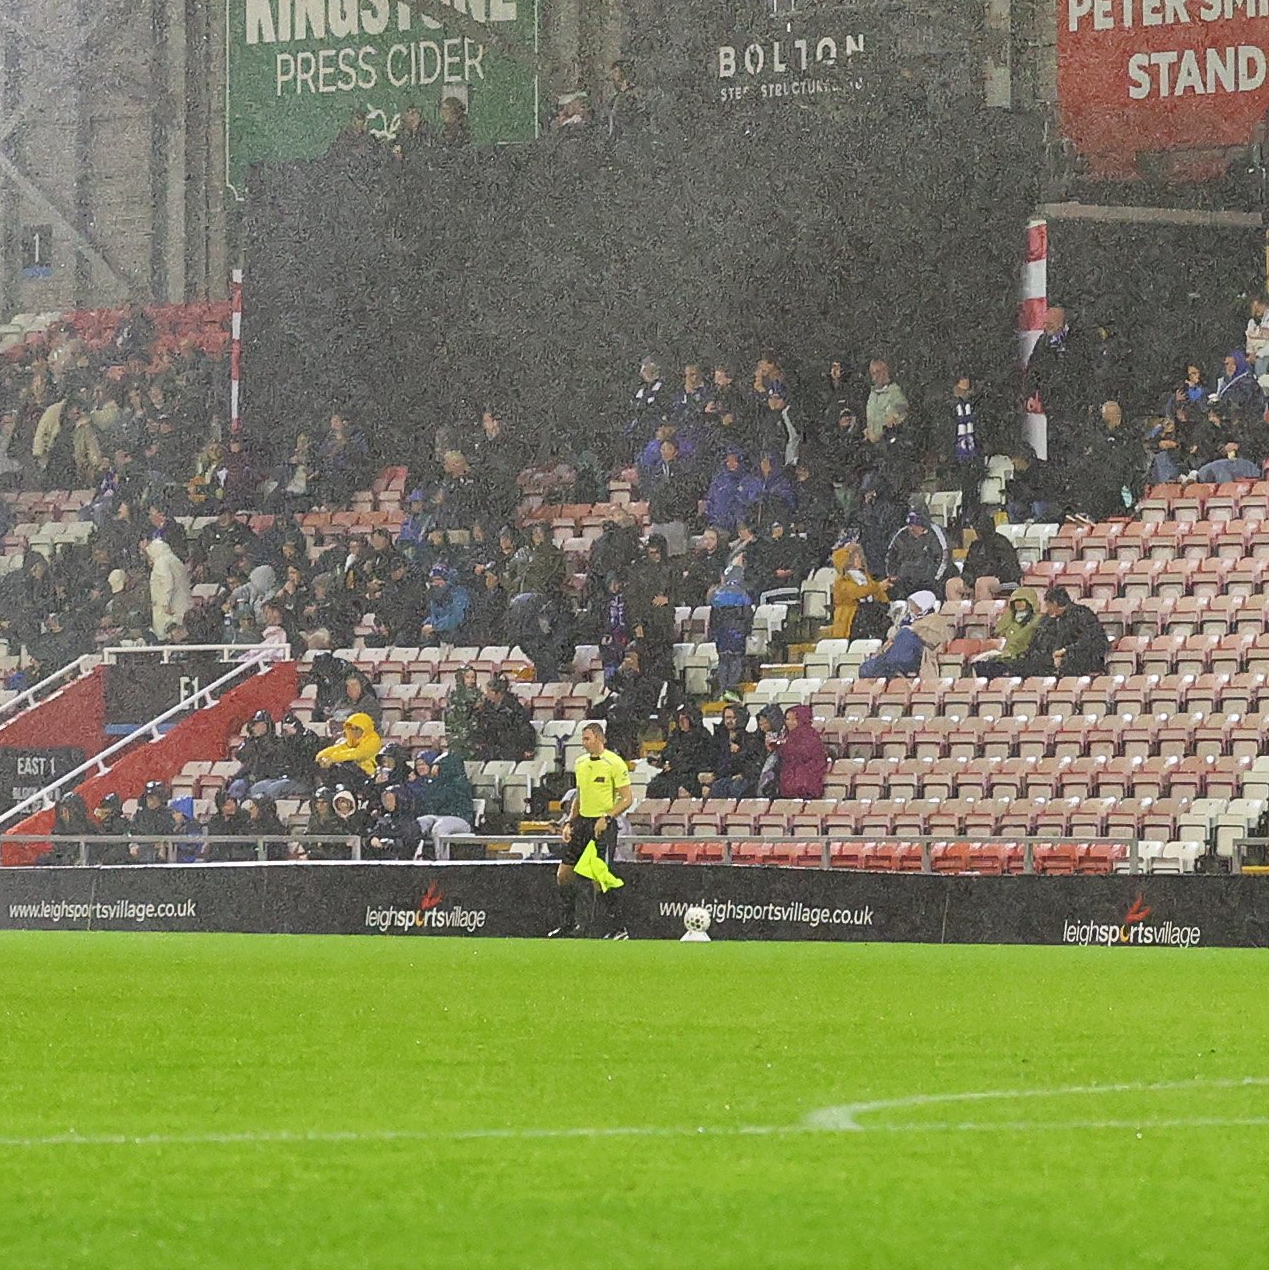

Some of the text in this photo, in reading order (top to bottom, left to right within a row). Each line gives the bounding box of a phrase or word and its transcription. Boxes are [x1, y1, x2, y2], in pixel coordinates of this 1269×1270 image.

[276, 37, 486, 96] PRESS CIDER
[1128, 45, 1268, 99] STAND
[17, 756, 56, 776] EAST 1
[9, 899, 197, 922] www.leighsportsvillage.co.uk
